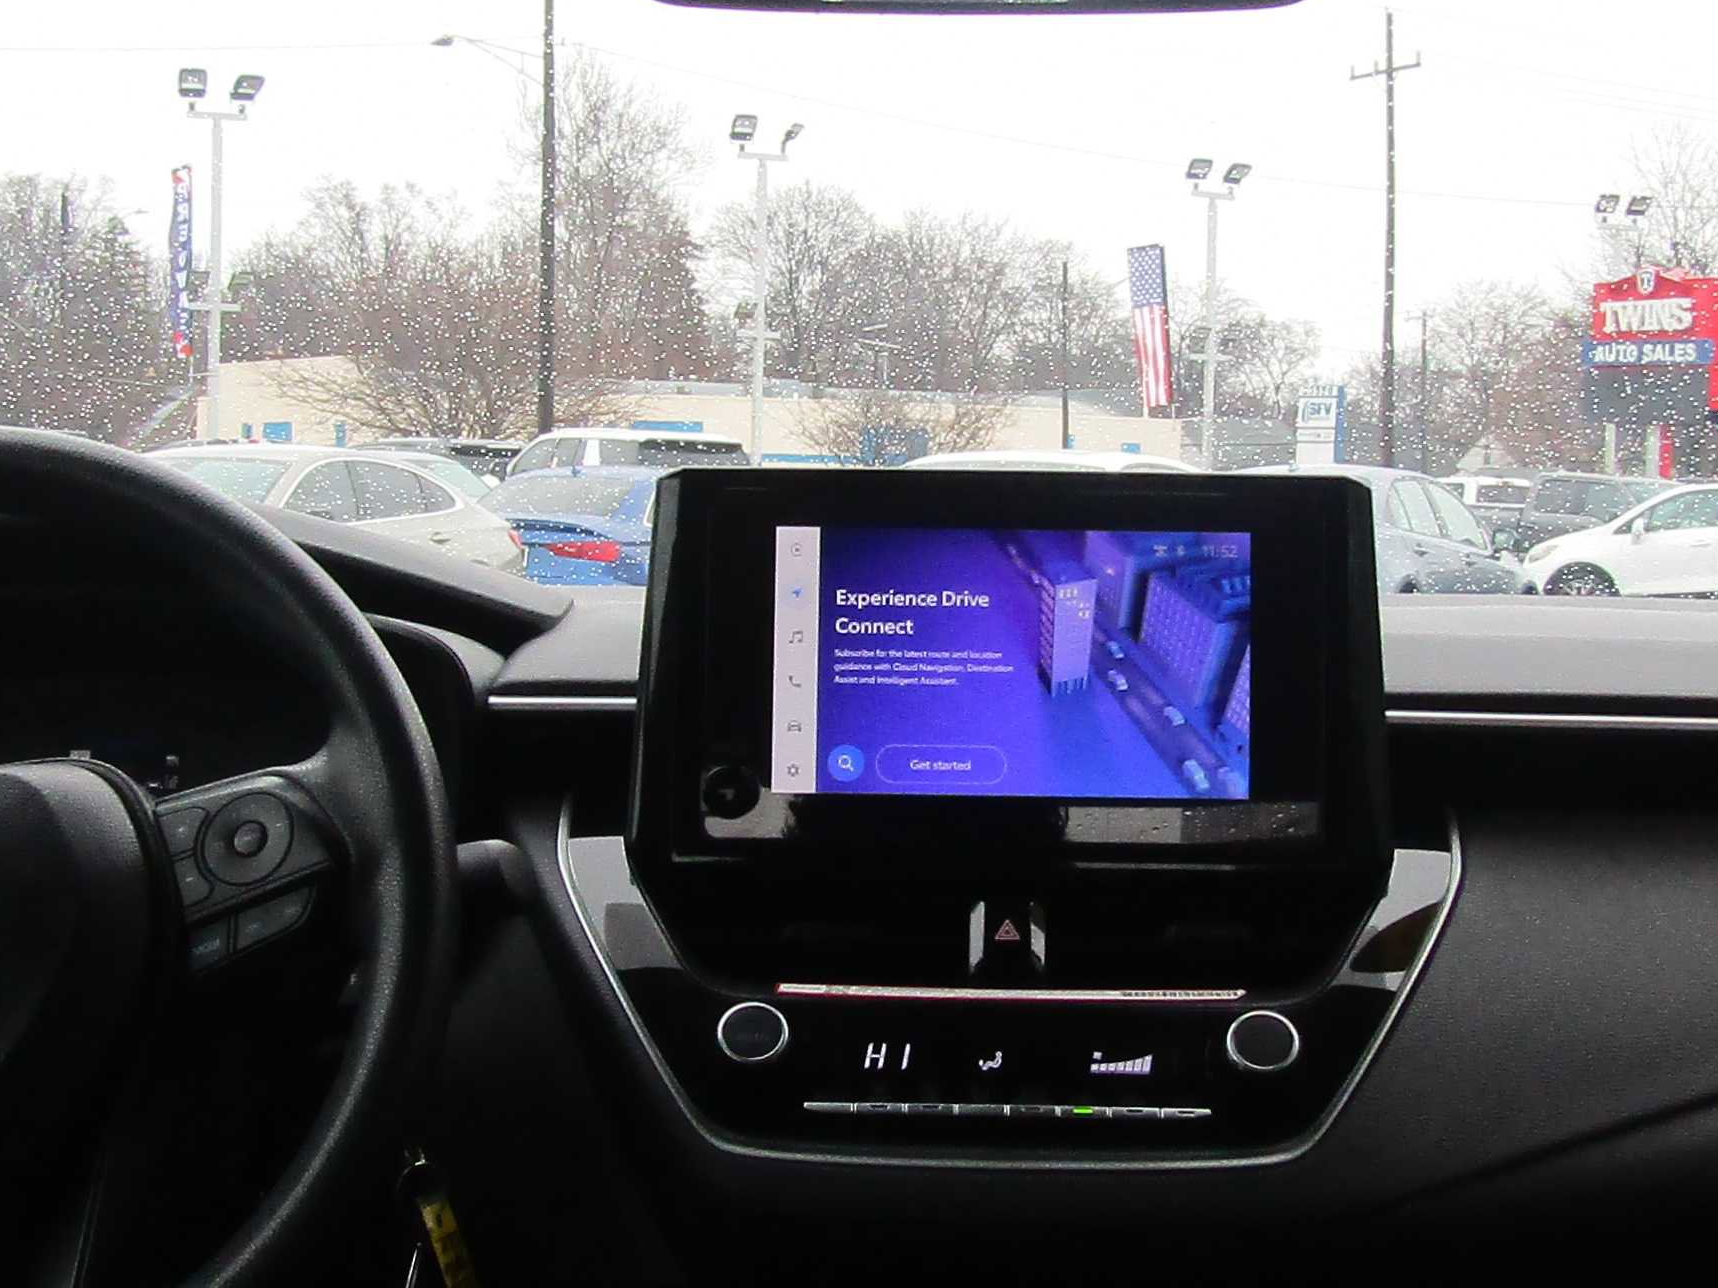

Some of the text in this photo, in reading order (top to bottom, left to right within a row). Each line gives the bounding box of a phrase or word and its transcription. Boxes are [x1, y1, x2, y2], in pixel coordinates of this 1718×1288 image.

[1599, 297, 1694, 334] TWINS
[1594, 342, 1698, 363] AUTO SALES
[835, 588, 990, 609] Experience Drive
[834, 616, 915, 635] Connect
[834, 649, 875, 658] Subscribe
[876, 649, 887, 658] for
[888, 649, 902, 658] the
[904, 649, 927, 659] latest
[952, 650, 968, 659] and
[833, 662, 873, 672] guidance
[874, 662, 891, 671] with
[893, 662, 918, 672] Cloud
[833, 675, 858, 684] Assist
[859, 675, 875, 684] and
[877, 676, 918, 685] Intelligent
[909, 759, 972, 771] Get started
